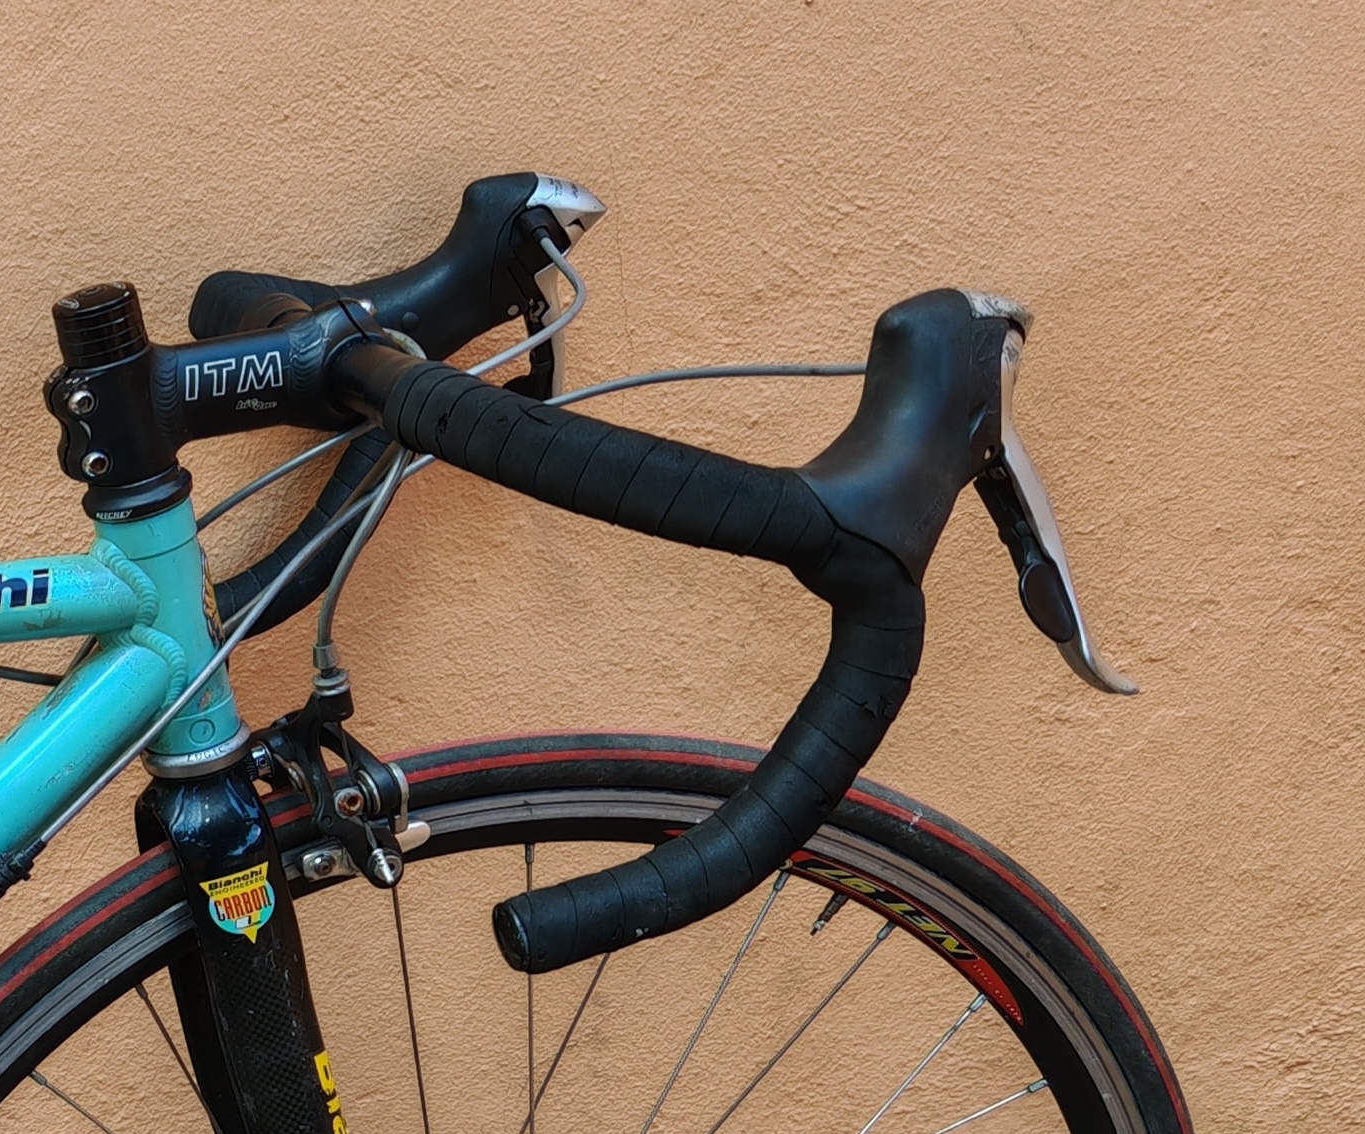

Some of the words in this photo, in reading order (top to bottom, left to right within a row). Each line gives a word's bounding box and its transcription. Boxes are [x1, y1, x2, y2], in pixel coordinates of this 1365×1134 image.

[185, 350, 284, 402] ITM
[208, 867, 263, 891] Bianchi
[807, 866, 887, 894] 97
[875, 898, 976, 957] NET
